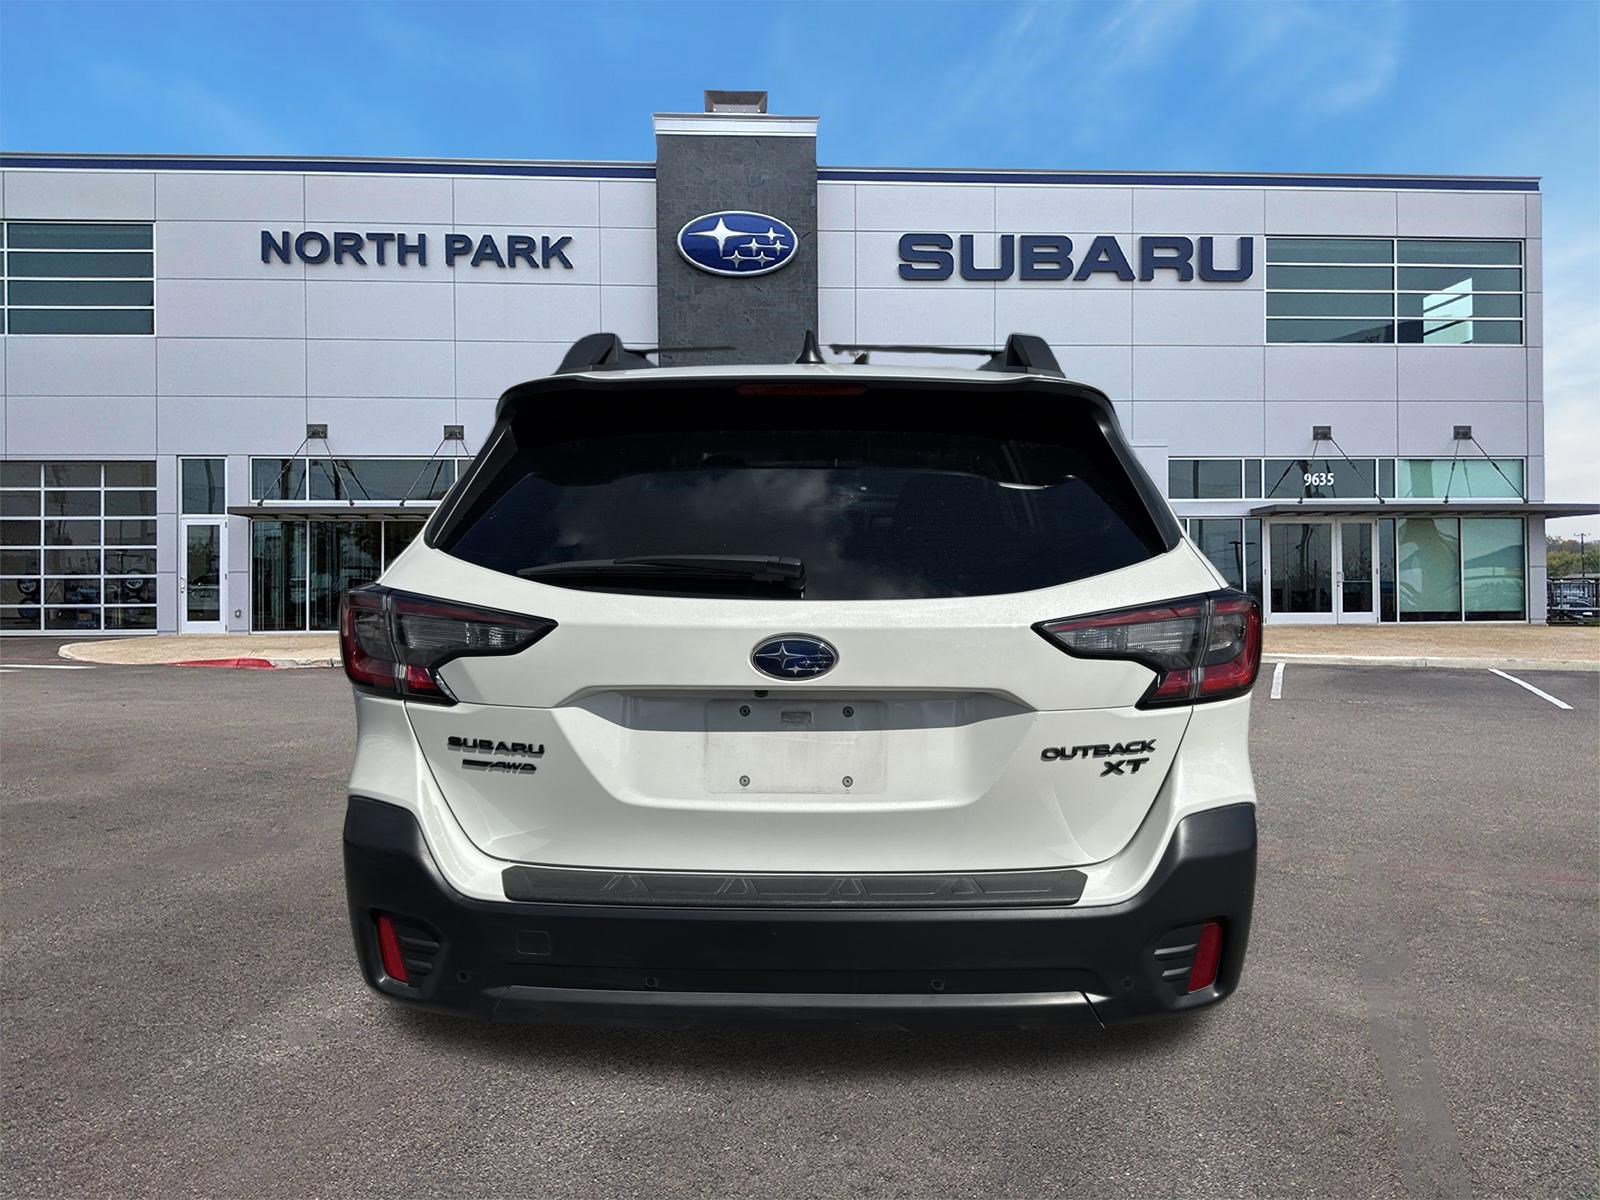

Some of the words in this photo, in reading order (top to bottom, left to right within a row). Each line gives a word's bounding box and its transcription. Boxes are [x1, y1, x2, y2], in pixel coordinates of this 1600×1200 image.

[261, 230, 428, 269] NORTH
[445, 233, 574, 270] PARK
[898, 232, 1254, 284] SUBARU
[1303, 472, 1335, 487] 9635
[447, 735, 545, 757] SUBARU
[1040, 738, 1157, 762] OUTBACK
[488, 760, 537, 775] AWD
[1099, 757, 1150, 778] XT
